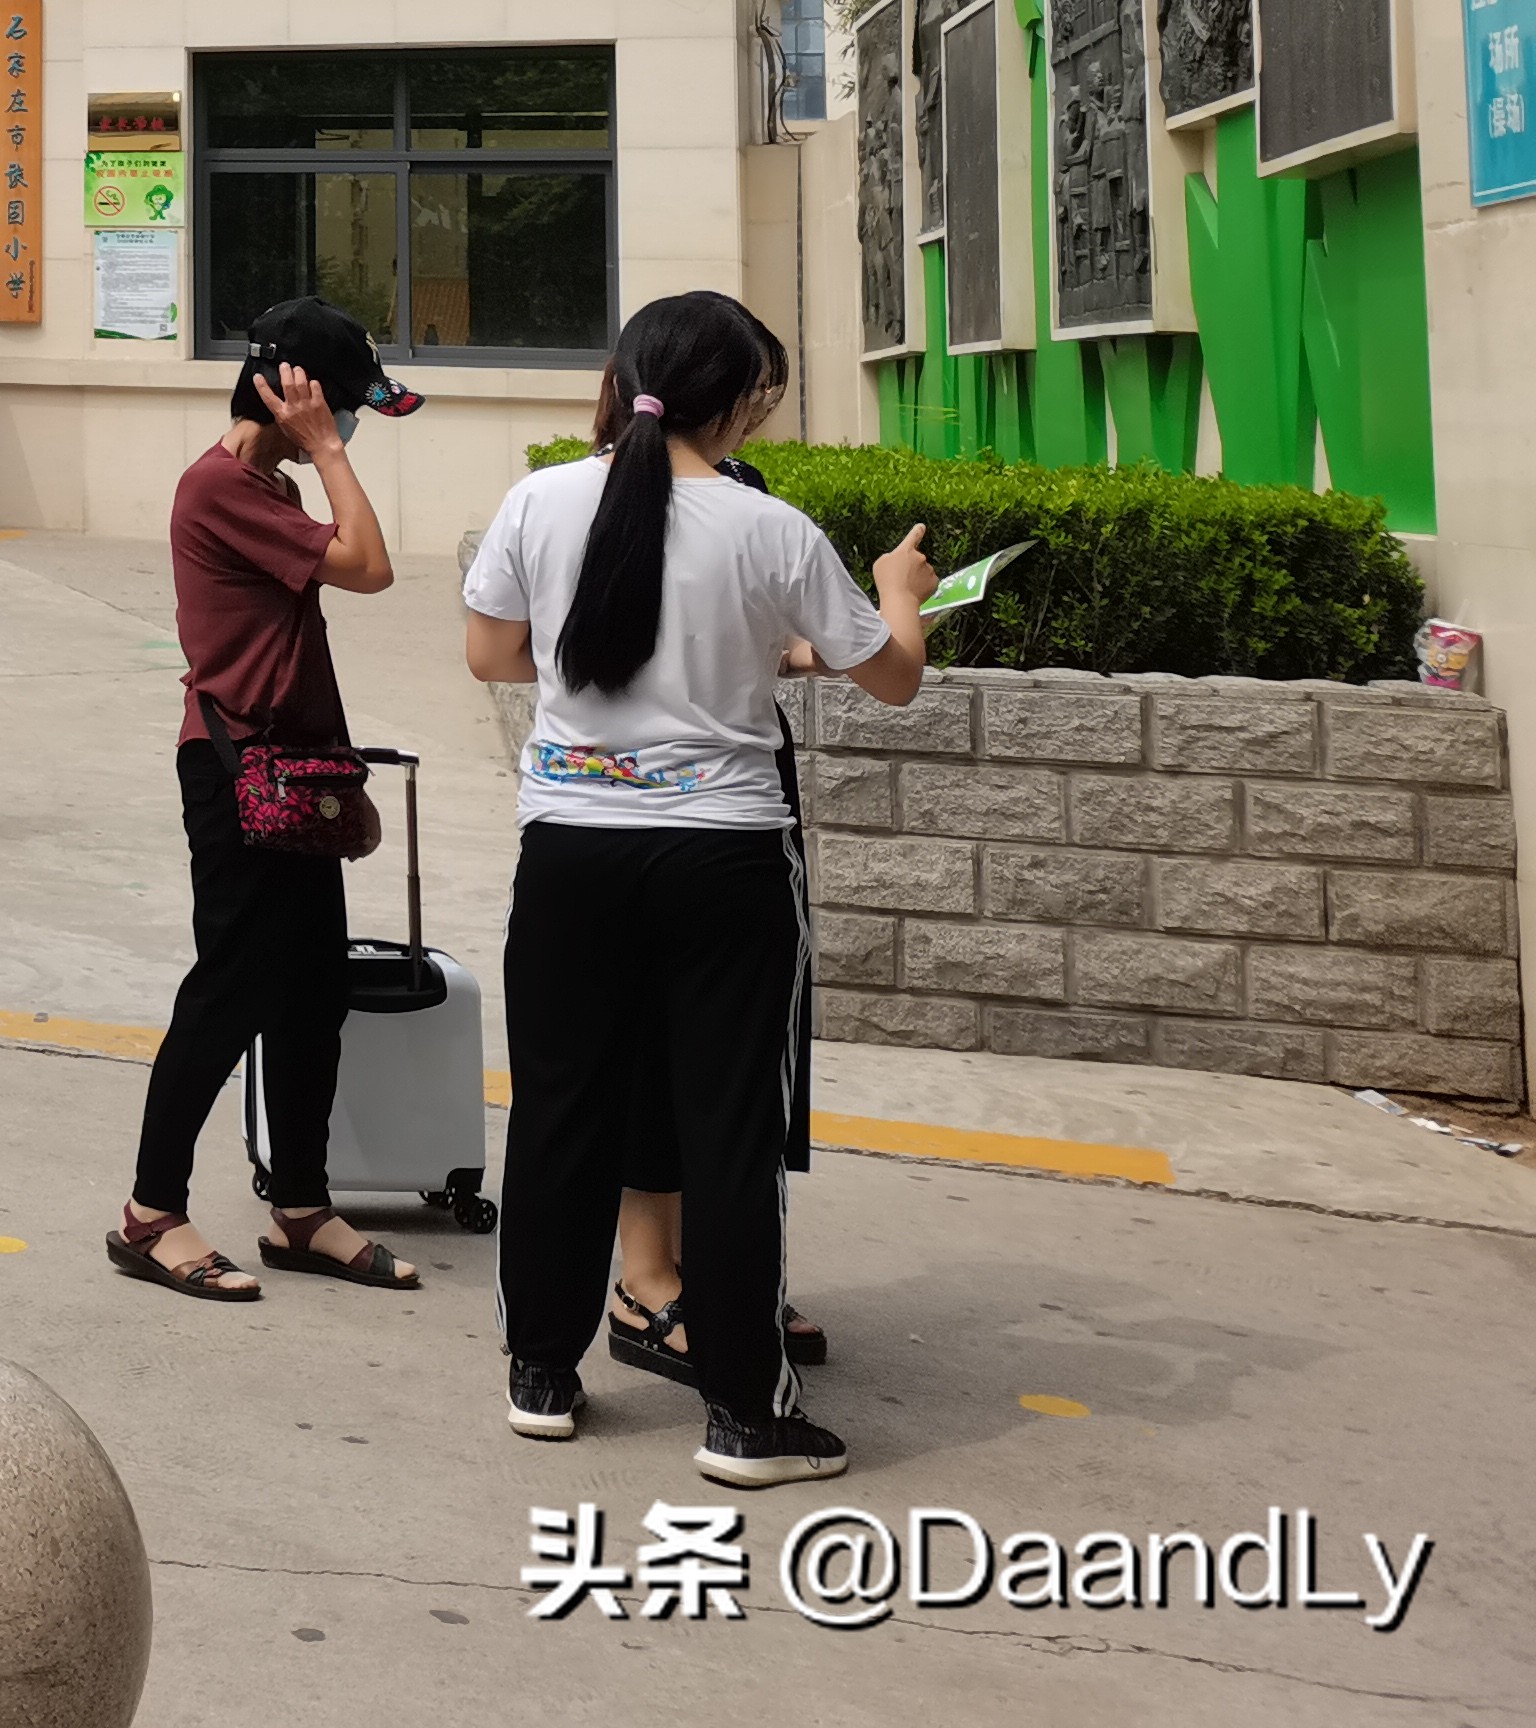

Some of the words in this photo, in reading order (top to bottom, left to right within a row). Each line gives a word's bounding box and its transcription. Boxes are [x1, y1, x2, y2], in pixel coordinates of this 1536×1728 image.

[1489, 24, 1520, 74] 场所
[4, 15, 29, 300] 石家庄市谈固小学
